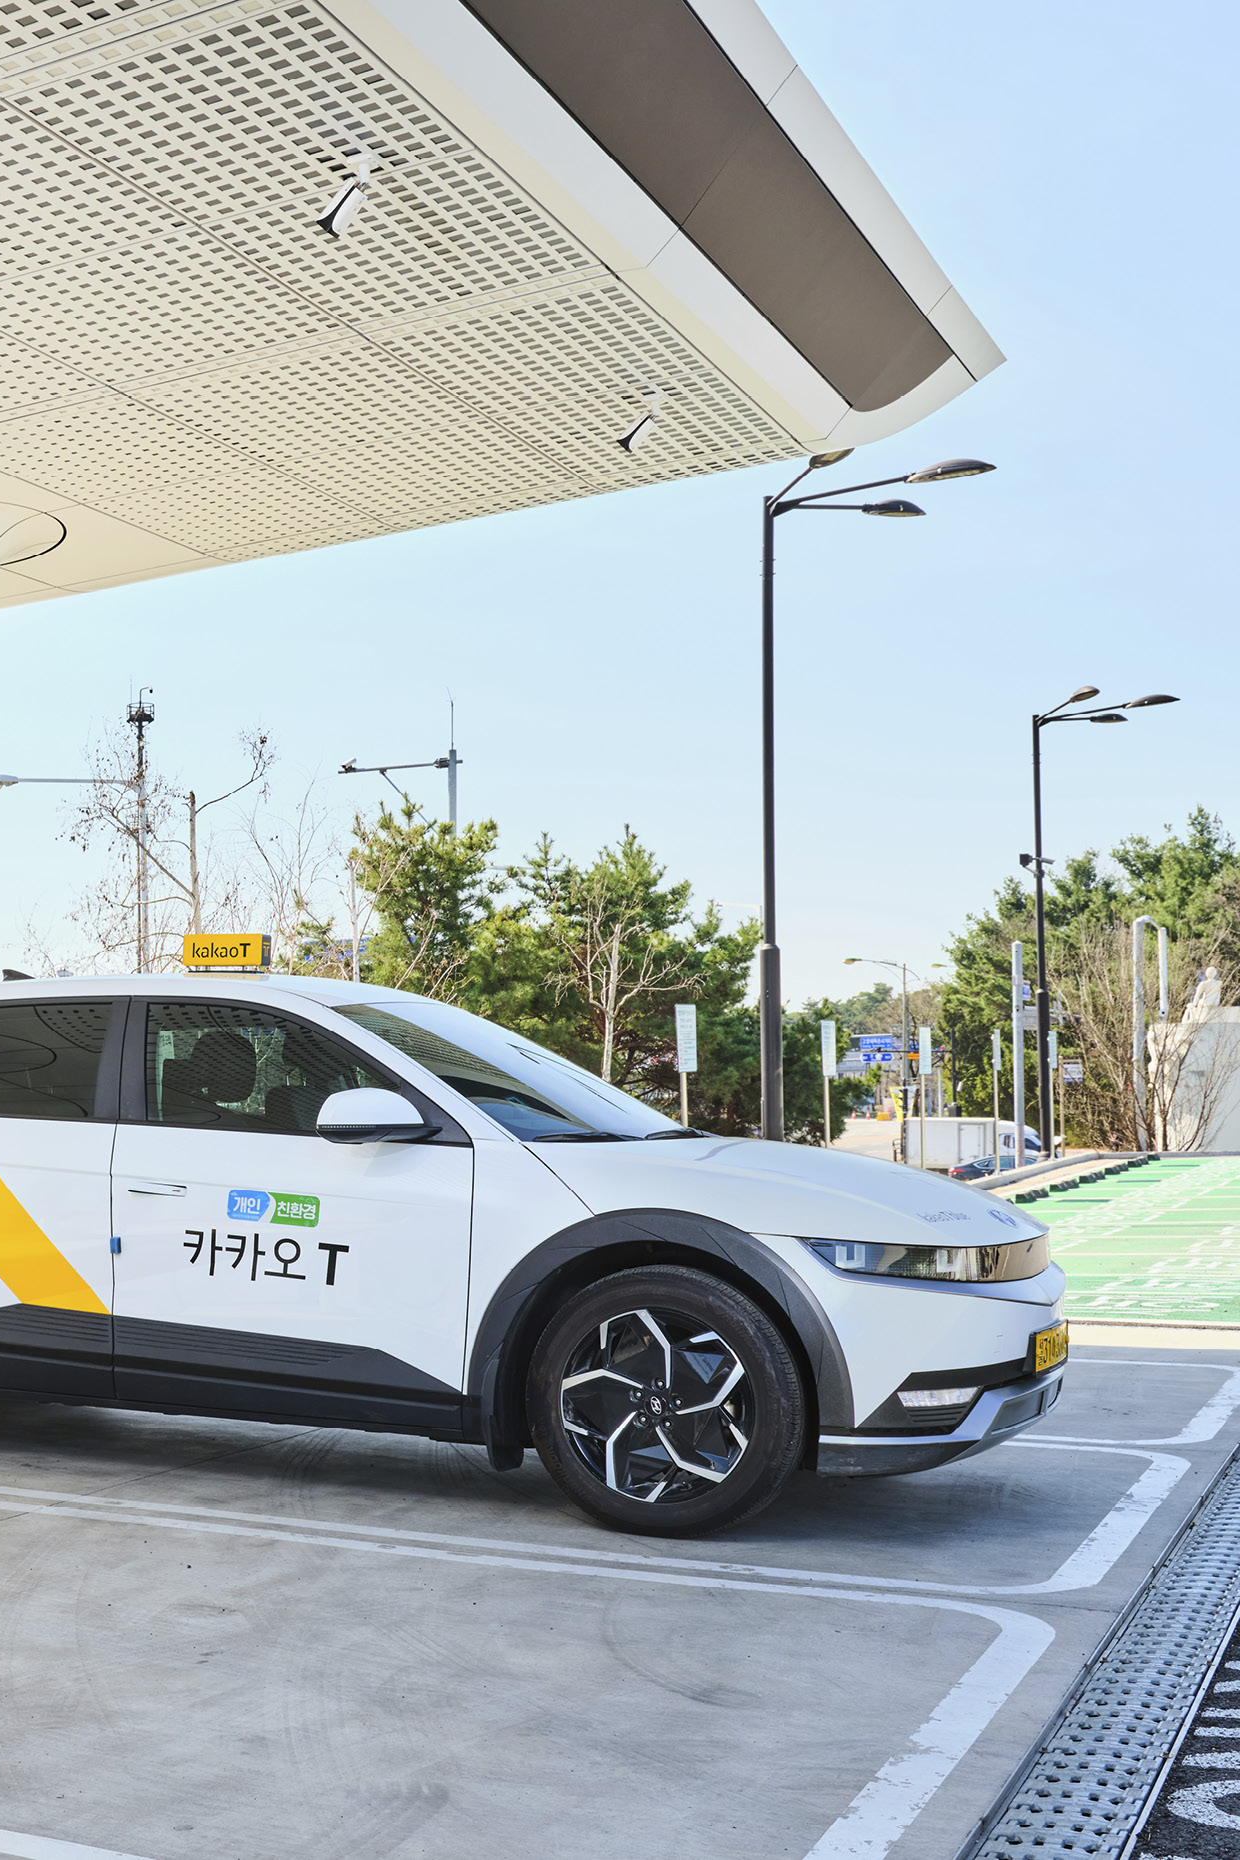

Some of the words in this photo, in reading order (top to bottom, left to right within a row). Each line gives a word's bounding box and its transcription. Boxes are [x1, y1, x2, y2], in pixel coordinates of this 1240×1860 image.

[233, 1196, 261, 1215] 개인
[277, 1201, 316, 1220] 친환경
[183, 1229, 306, 1281] 카카오
[318, 1242, 350, 1286] T
